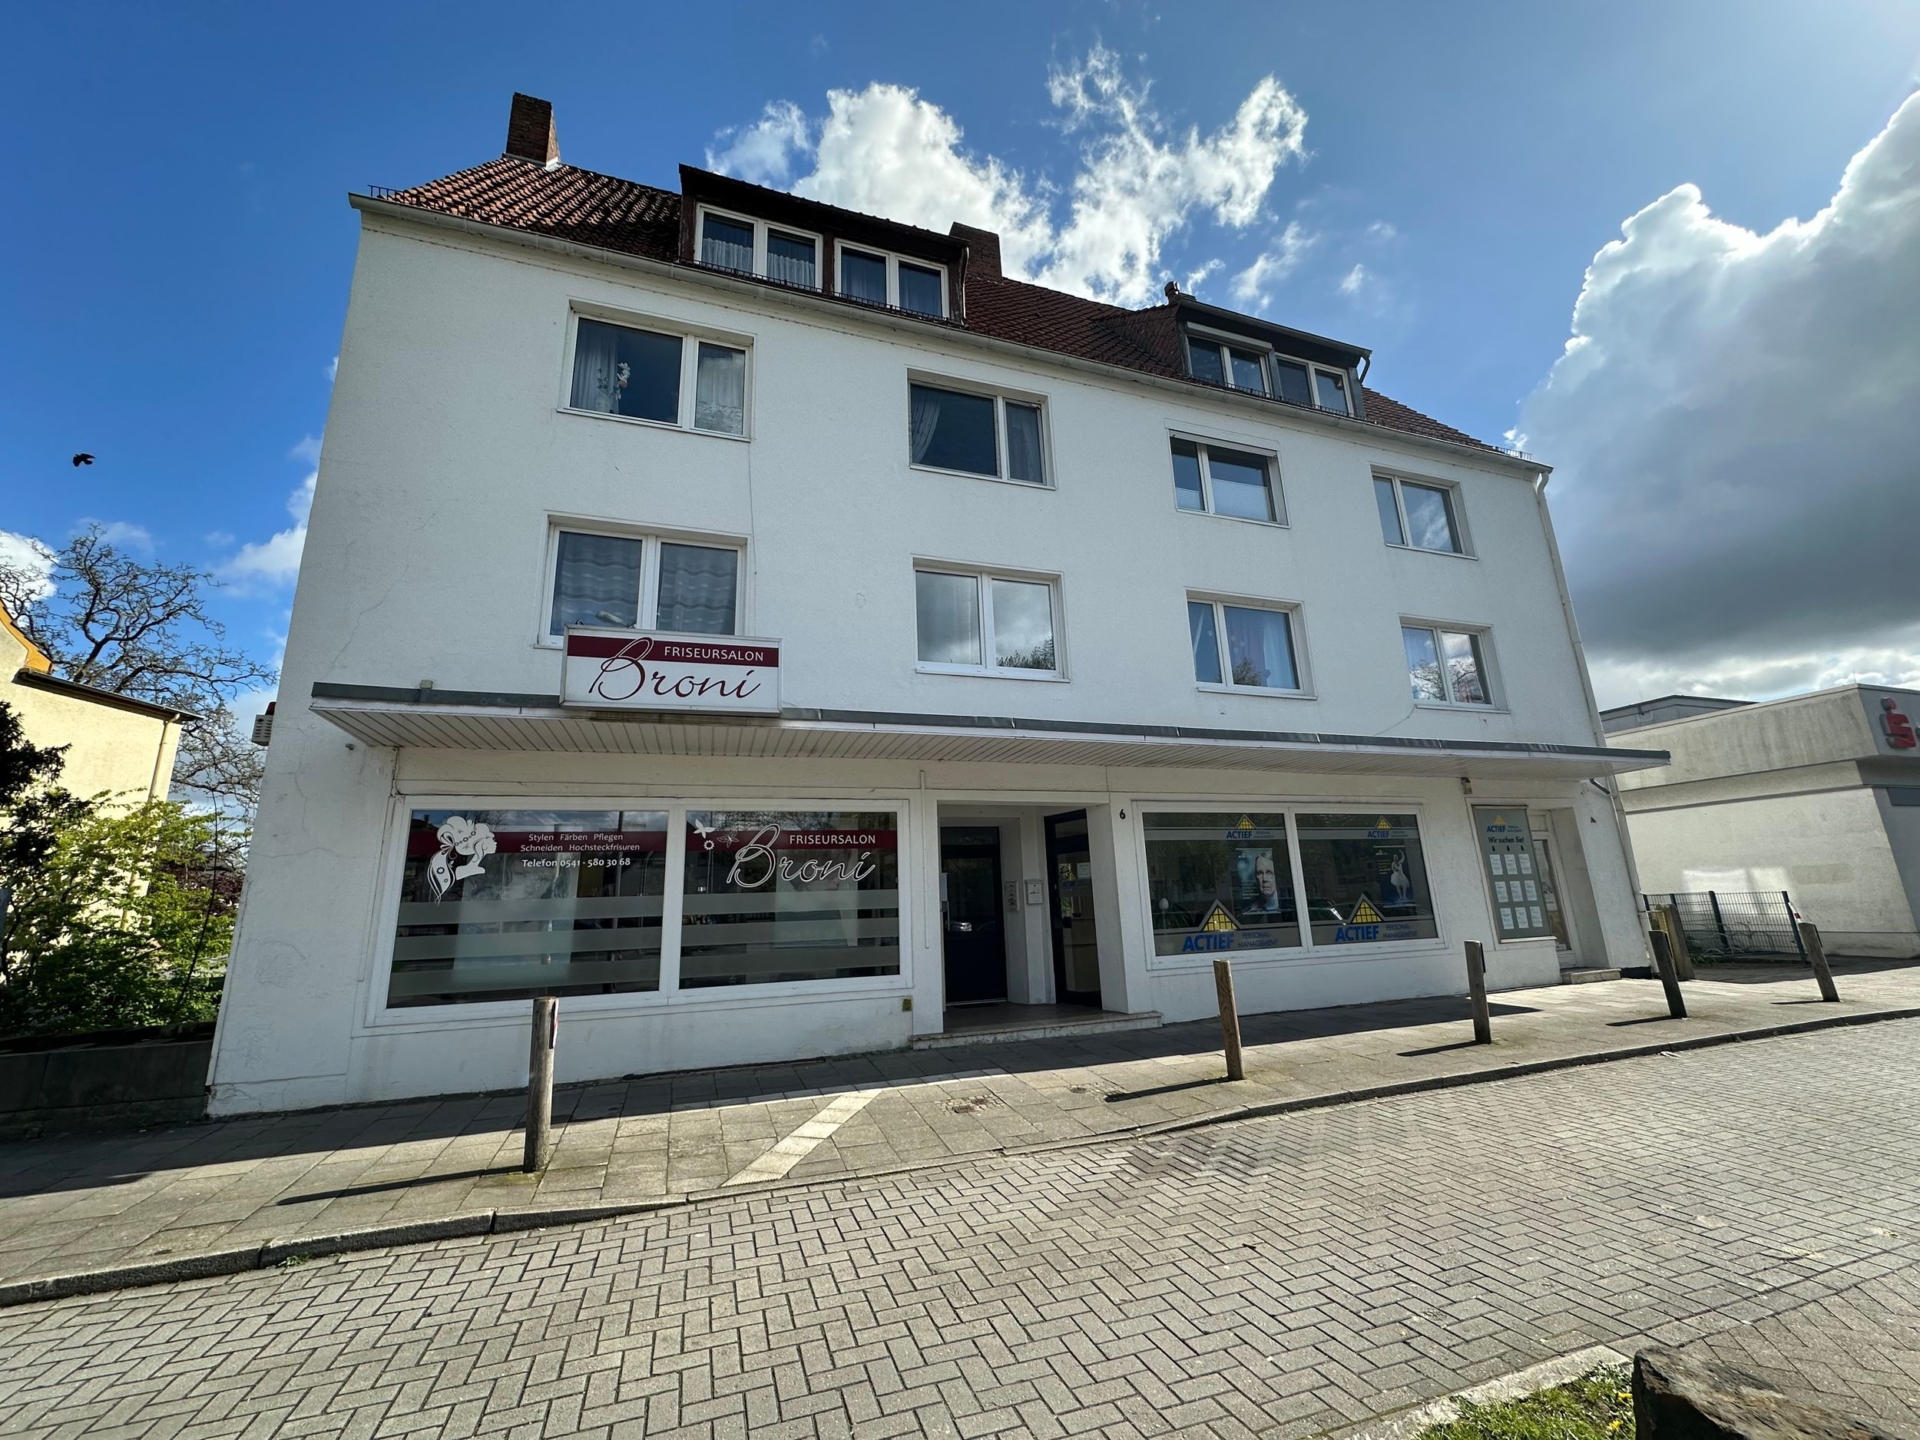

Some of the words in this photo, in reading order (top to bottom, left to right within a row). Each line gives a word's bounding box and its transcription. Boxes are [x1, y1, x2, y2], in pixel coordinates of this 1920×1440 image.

[664, 646, 764, 662] FRISEURSALON
[588, 636, 761, 701] Broni
[1119, 808, 1126, 820] 6
[1367, 830, 1390, 838] ACTIEF
[1487, 825, 1506, 833] ACTIEF
[528, 833, 555, 842] Stylen
[560, 833, 588, 841] Färben
[593, 833, 624, 842] Pflegen
[789, 834, 876, 845] FRISEURSALON
[1226, 830, 1252, 839] ACTIEF
[520, 844, 563, 852] Schneiden
[569, 843, 640, 851] Hochsteckfrisuren
[726, 823, 876, 888] Broni
[522, 859, 558, 868] Telefon
[560, 860, 580, 868] 0541
[587, 858, 604, 868] 580
[606, 859, 617, 867] 30
[619, 858, 631, 866] 68
[1335, 925, 1379, 942] ACTIEF
[1382, 930, 1418, 939] MANAGEMENT
[1182, 932, 1235, 952] ACTIEF
[1237, 939, 1279, 949] MANAGEMENT
